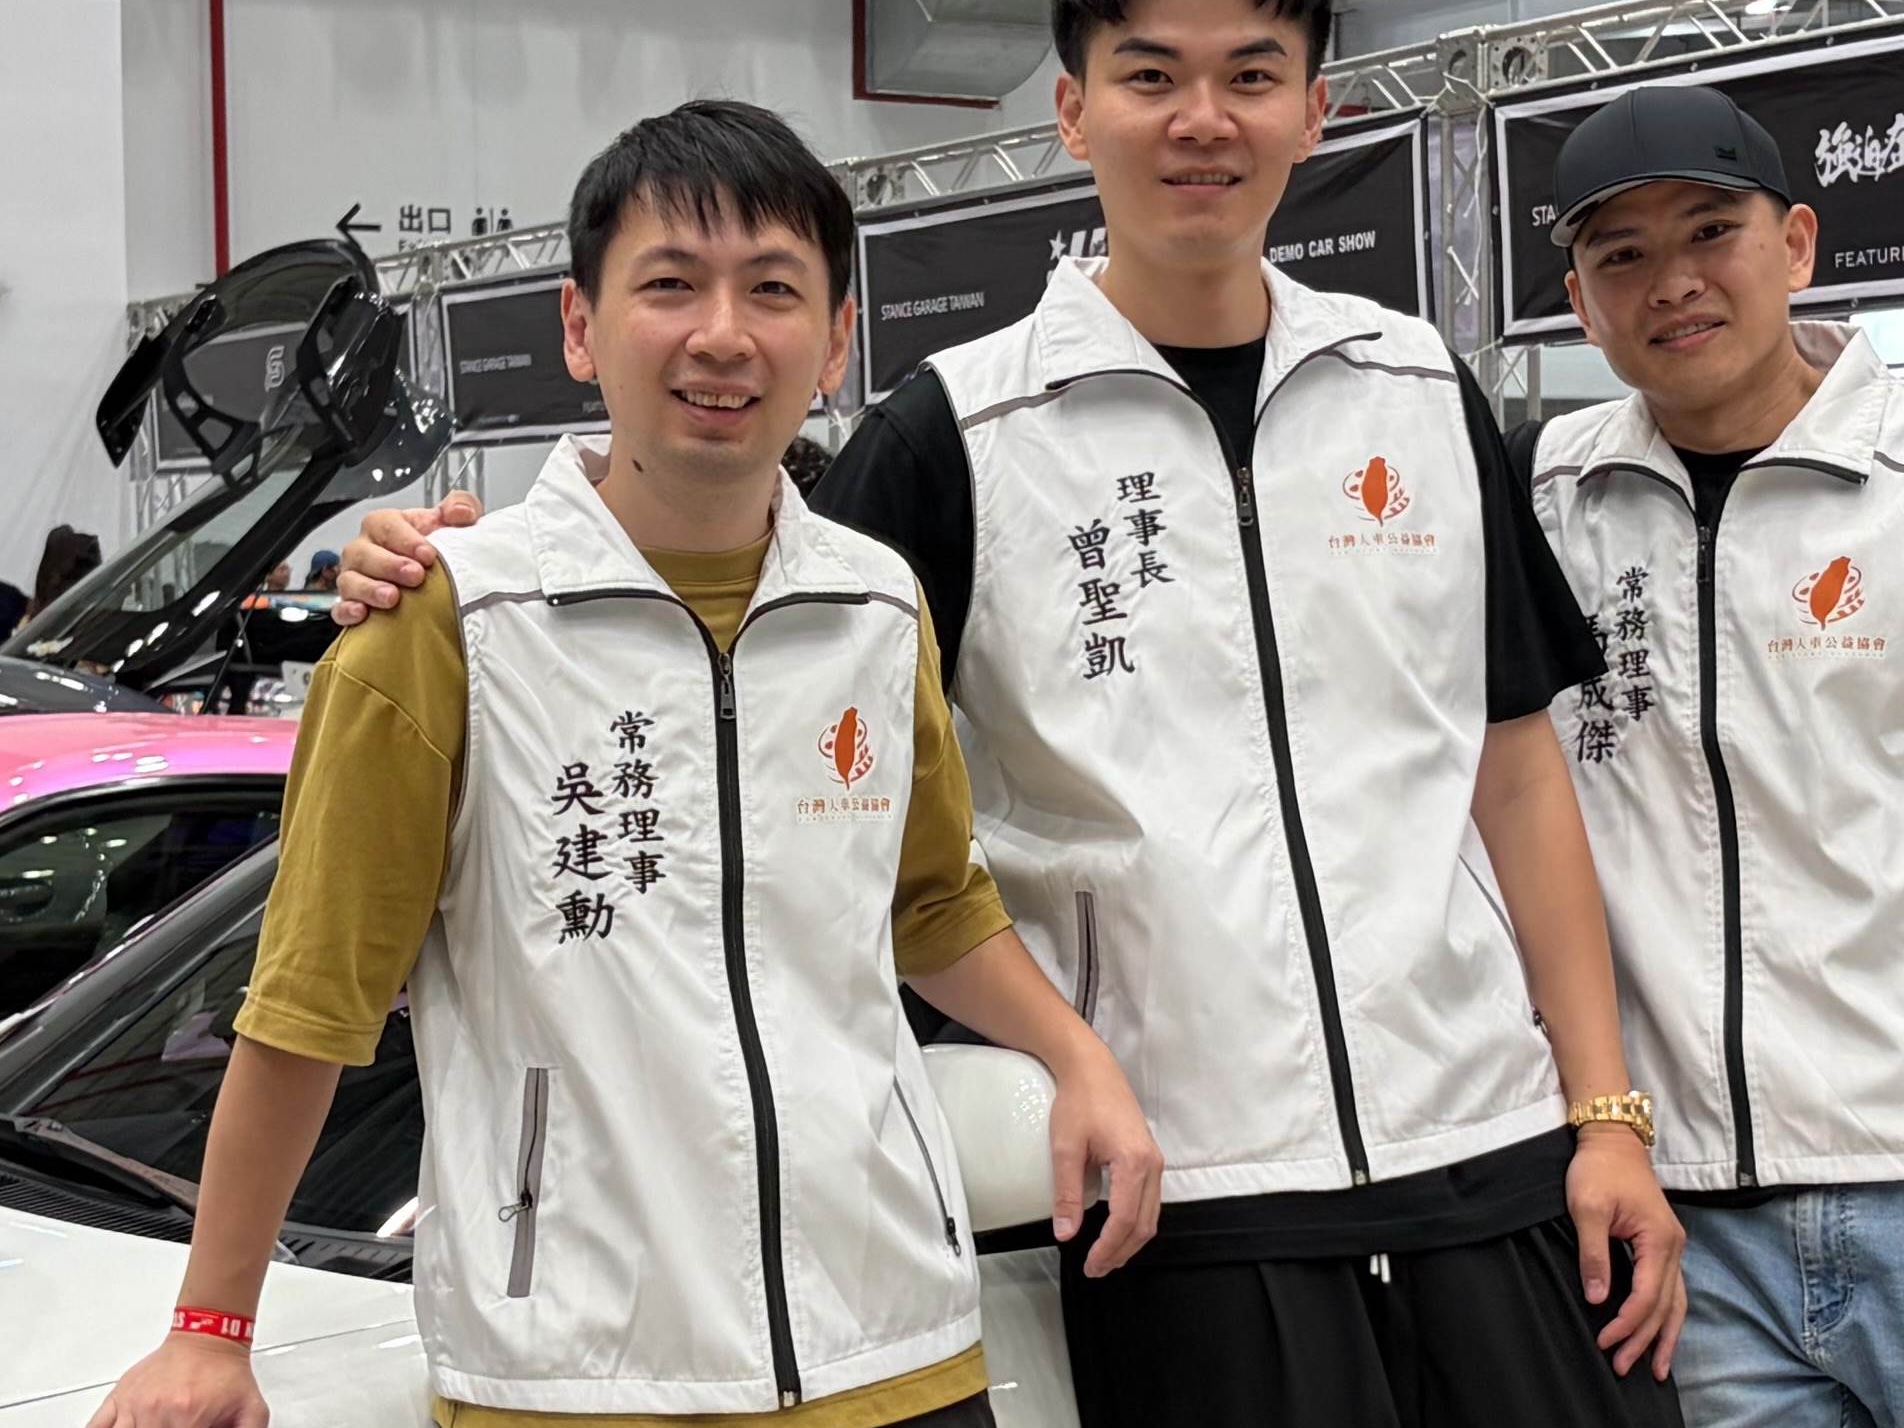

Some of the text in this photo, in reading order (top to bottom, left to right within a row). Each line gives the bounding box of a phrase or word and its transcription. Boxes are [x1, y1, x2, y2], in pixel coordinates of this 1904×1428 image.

[399, 204, 452, 234] 出口
[1270, 230, 1376, 264] DEMO CAR SHOW
[881, 292, 984, 321] STANCE GARAGE TAIWAN
[1117, 472, 1175, 589] 理事長
[1067, 518, 1136, 680] 曾聖凱
[1614, 566, 1655, 722] 常務理事
[551, 762, 614, 944] 吳建勳
[610, 711, 666, 894] 常務理事
